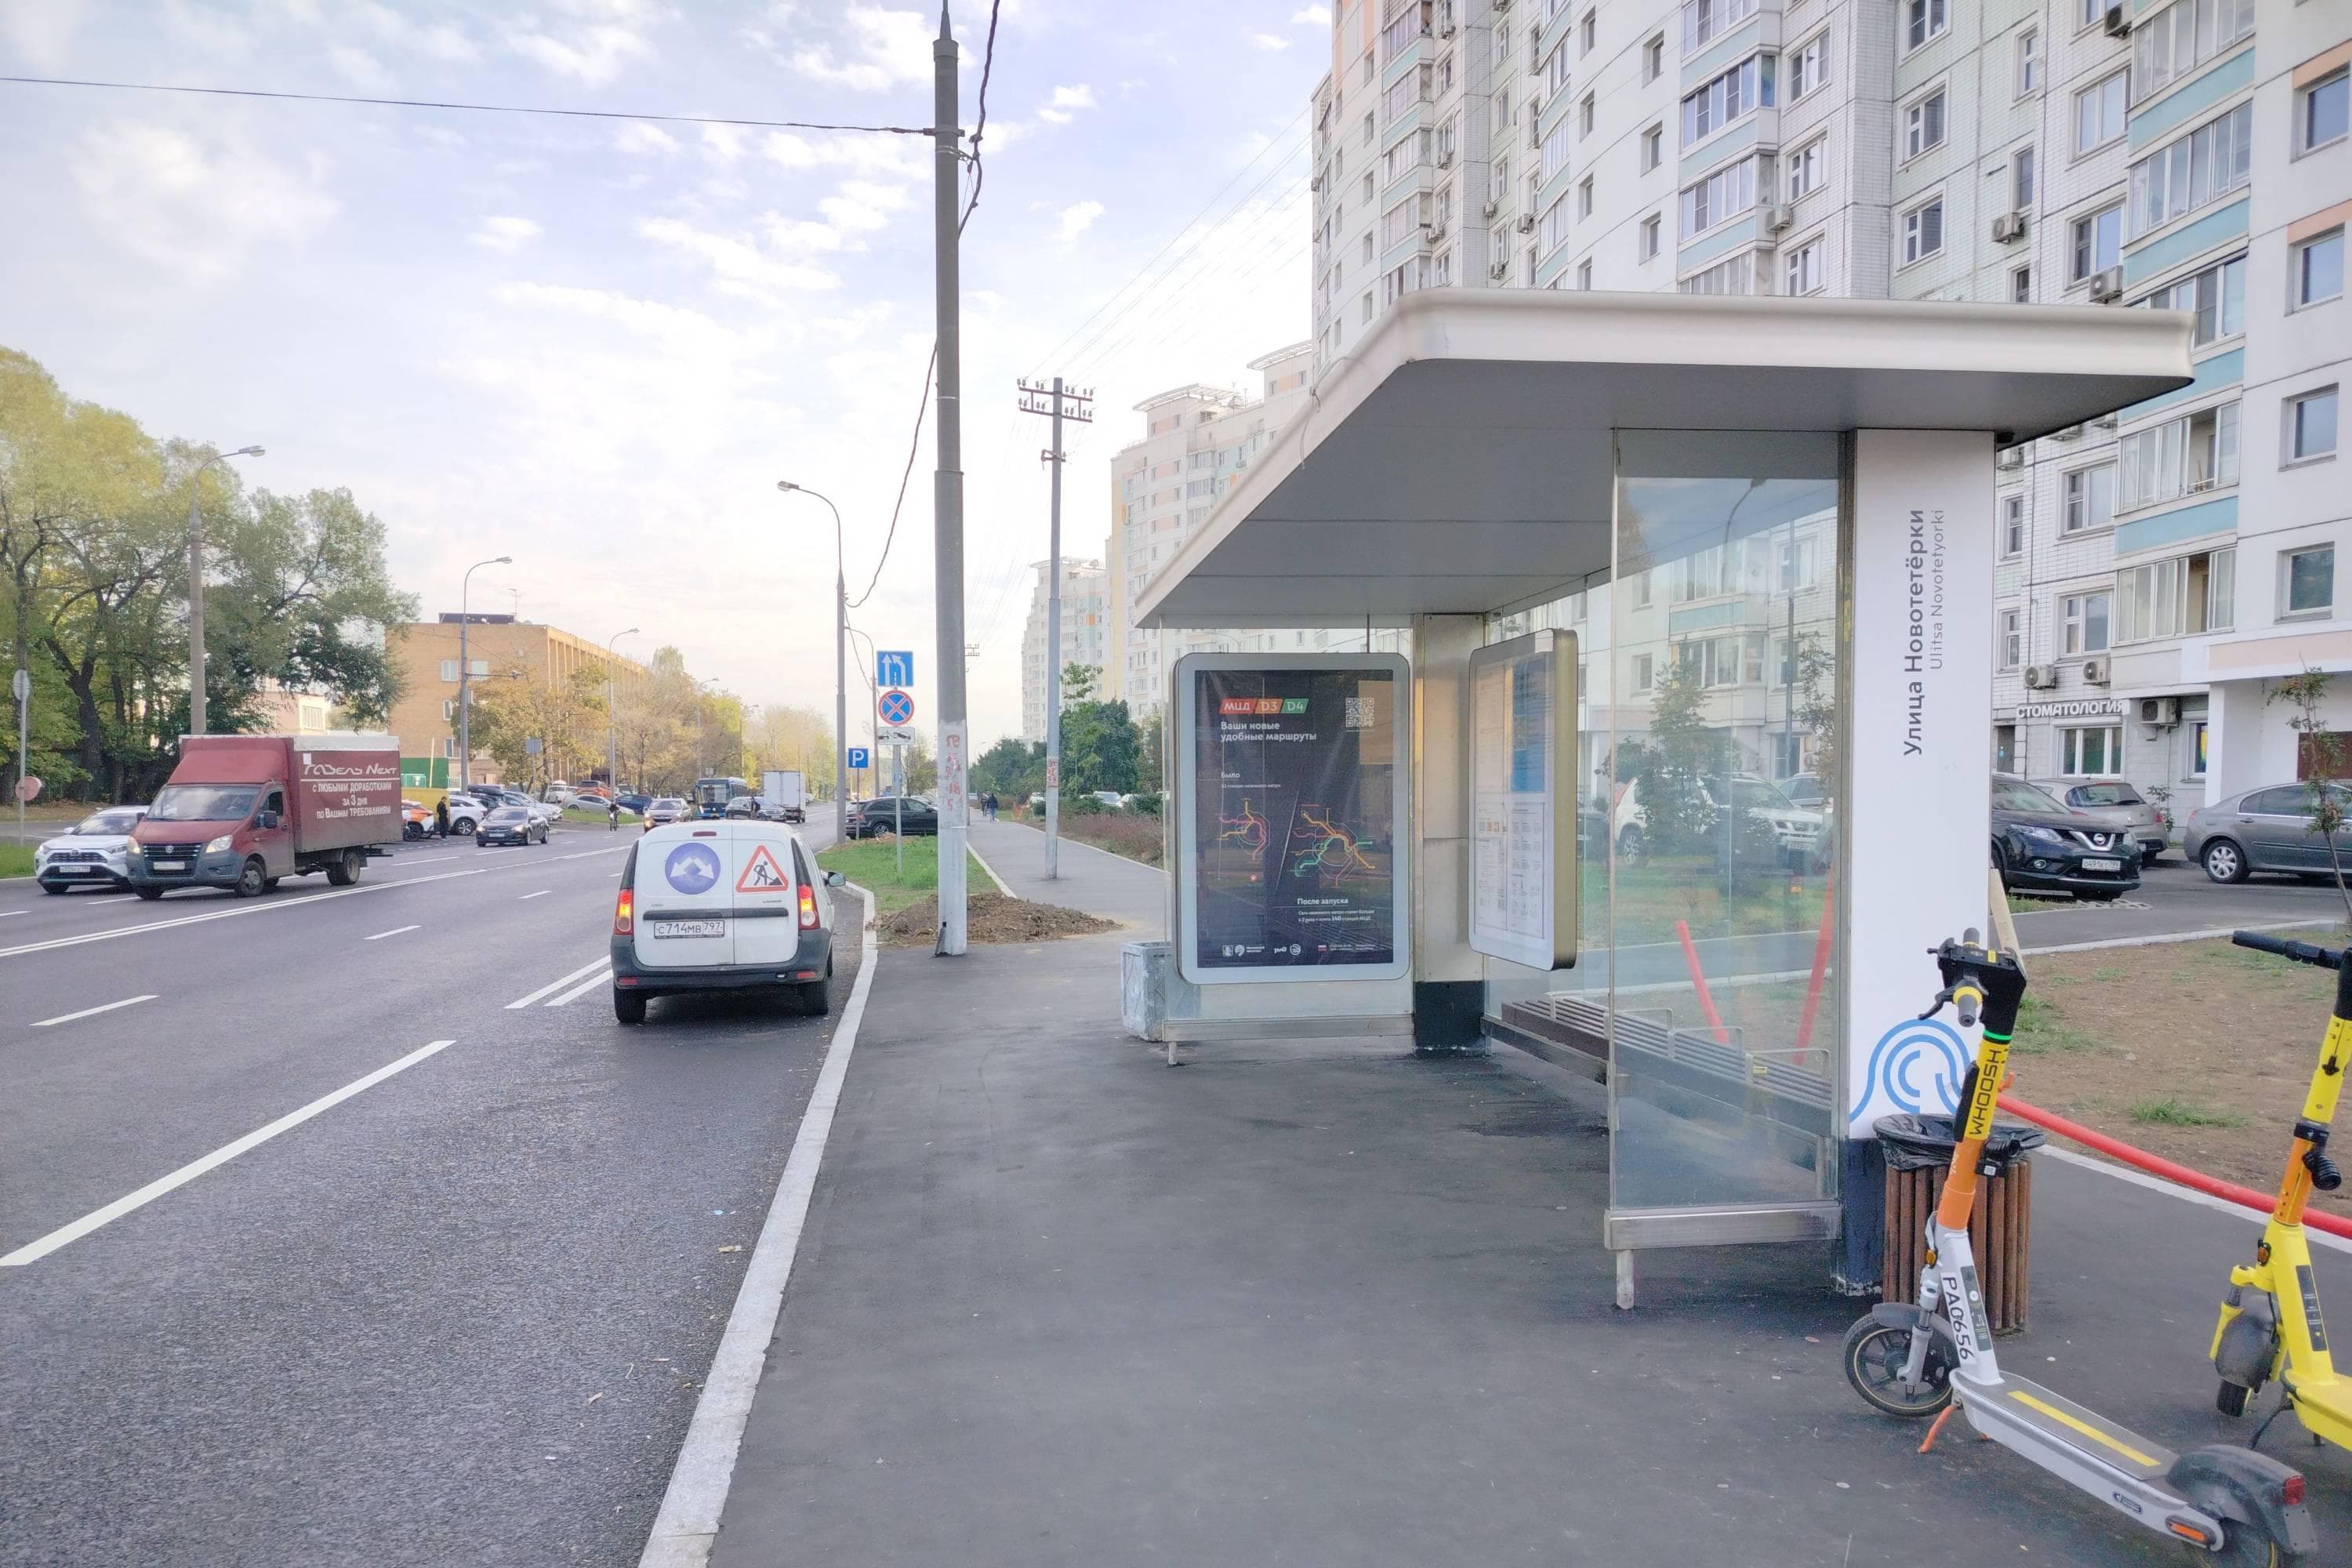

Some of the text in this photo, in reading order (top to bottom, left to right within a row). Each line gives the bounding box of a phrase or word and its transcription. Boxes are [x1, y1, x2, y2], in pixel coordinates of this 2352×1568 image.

[1930, 510, 1947, 670] Ulitsa Novotetyorki
[1904, 510, 1928, 756] Улица Новотетёрки
[1223, 701, 1305, 712] МЦД D3 D4
[2016, 700, 2124, 717] СТОМАТОЛОГИЯ
[1220, 721, 1280, 731] Ваши новые
[1220, 732, 1317, 742] удобные маршруты
[852, 750, 865, 767] P
[318, 782, 349, 793] ЛЮБЫМИ
[350, 782, 392, 793] ДОРАБОТКАМИ
[350, 794, 356, 806] 3
[349, 805, 391, 817] ТРЕБОВАНИЯМ
[1969, 1048, 2002, 1135] WHOOSH
